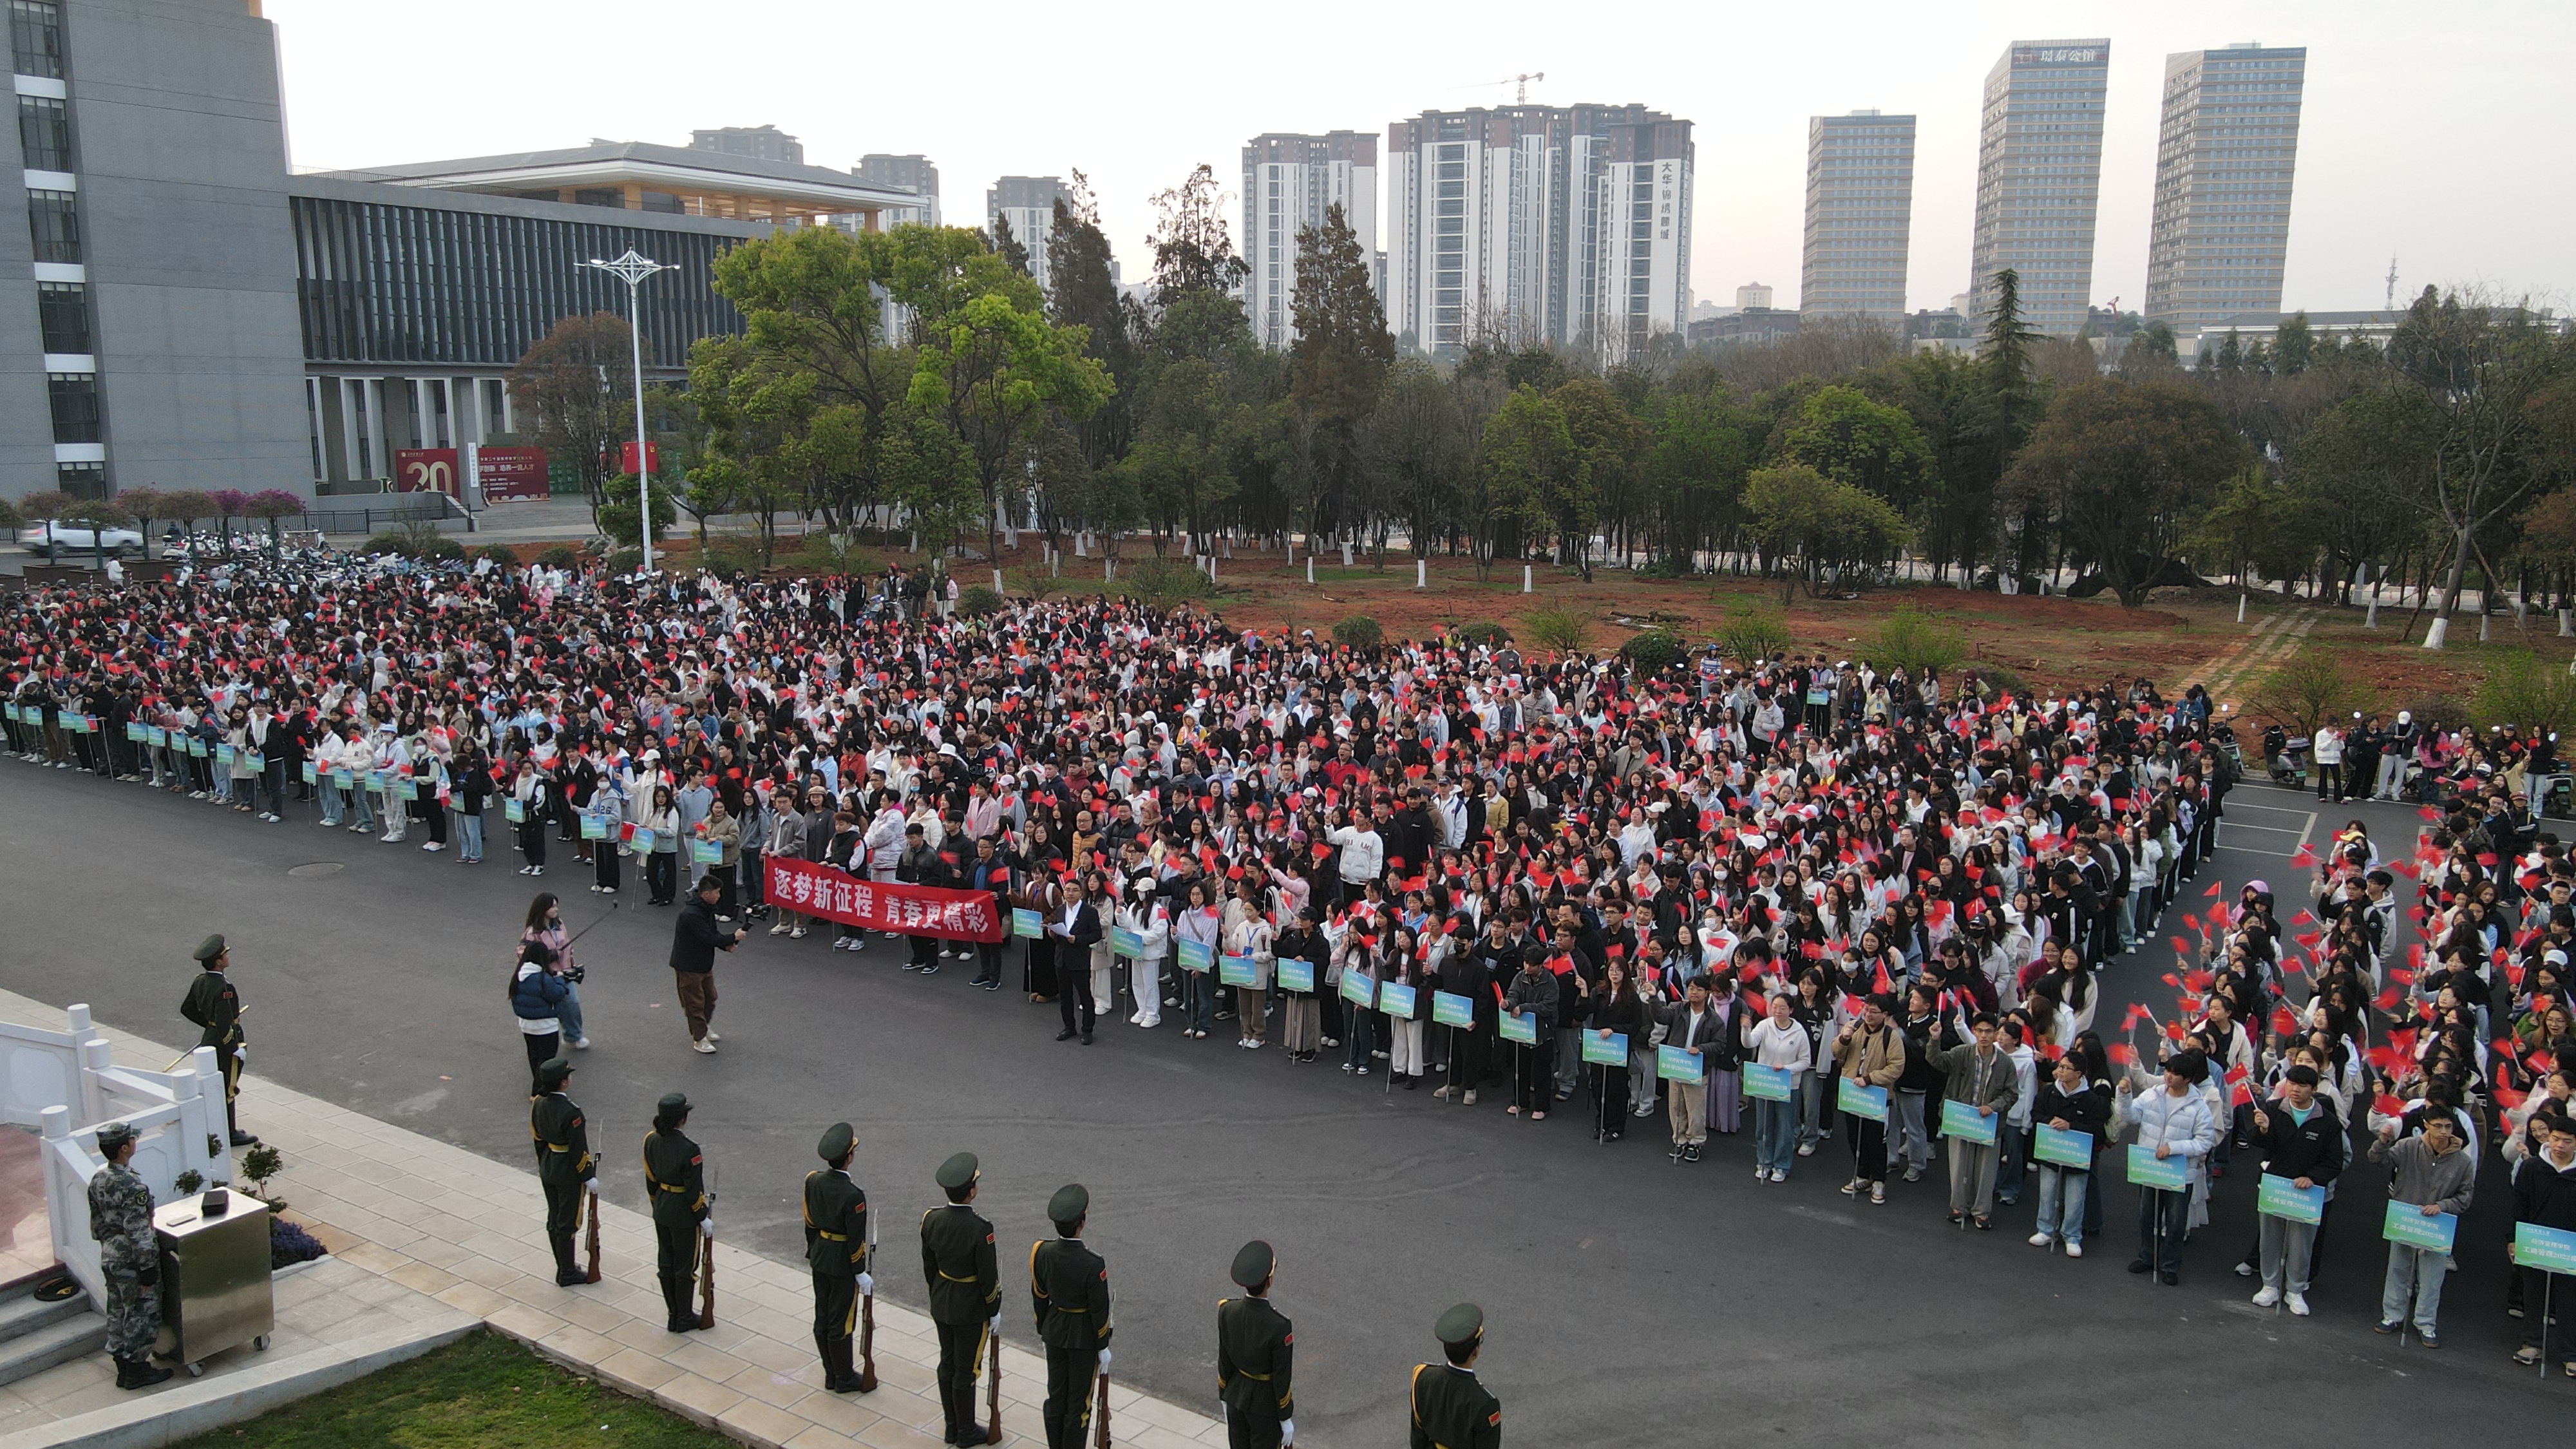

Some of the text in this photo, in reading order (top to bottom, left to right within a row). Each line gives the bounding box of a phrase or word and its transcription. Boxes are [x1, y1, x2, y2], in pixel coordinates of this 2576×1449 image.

[774, 867, 989, 933] 逐梦新征程 青春更精彩
